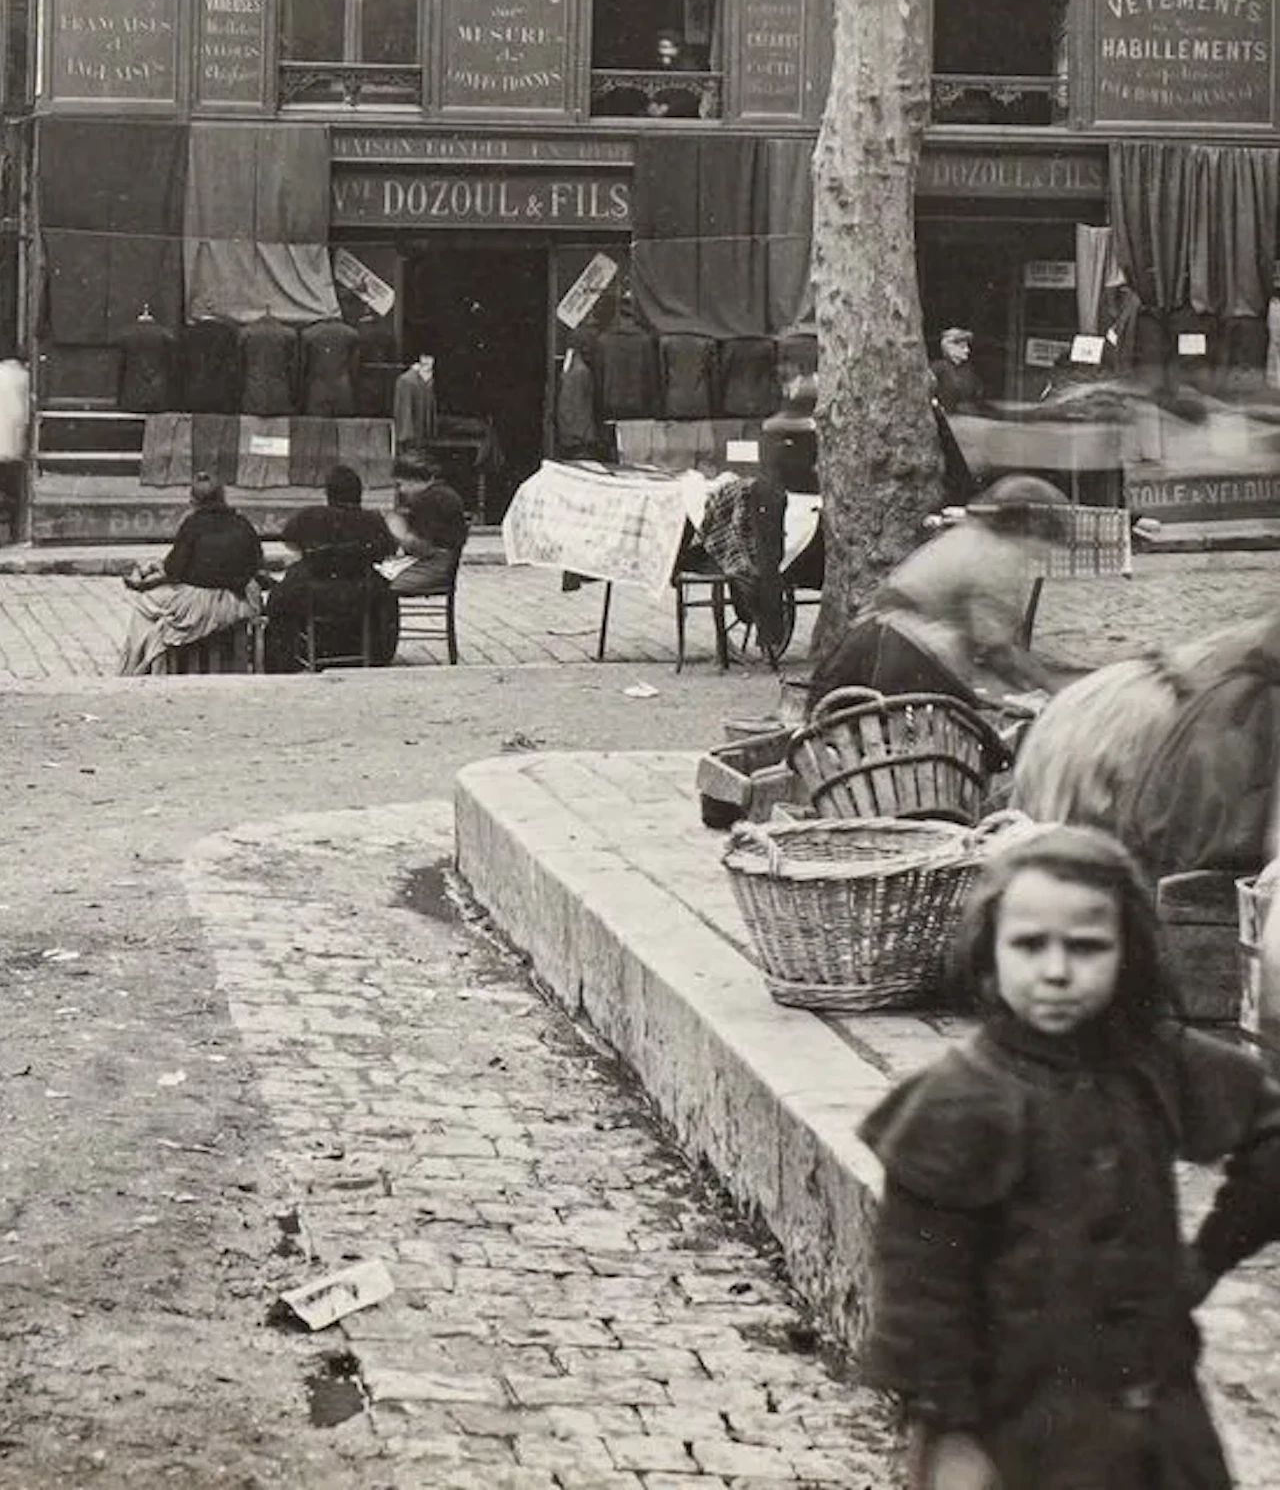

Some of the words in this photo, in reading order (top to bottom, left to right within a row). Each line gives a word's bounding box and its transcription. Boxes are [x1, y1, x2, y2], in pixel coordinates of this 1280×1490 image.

[1101, 37, 1269, 63] HABILLEMENTS
[383, 179, 519, 217] DOZOUL
[525, 193, 544, 218] &
[550, 182, 630, 219] FILS
